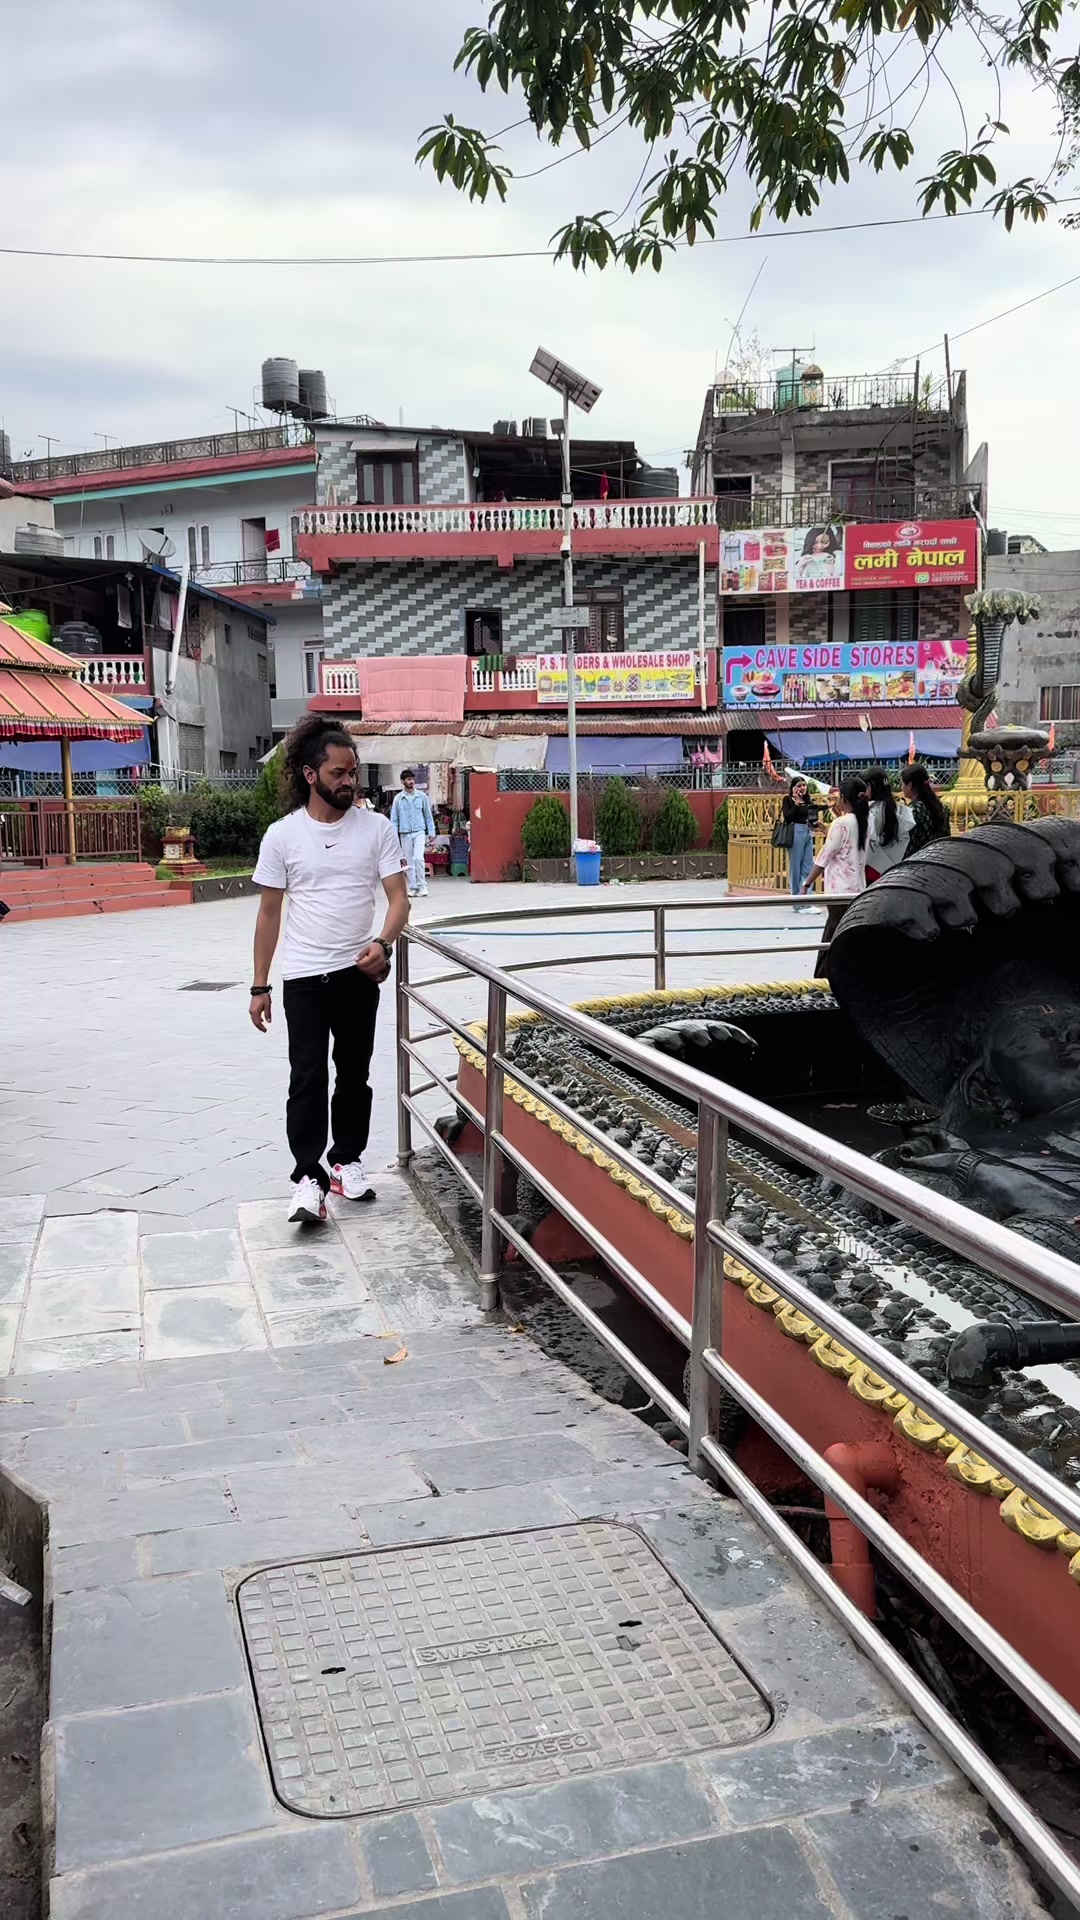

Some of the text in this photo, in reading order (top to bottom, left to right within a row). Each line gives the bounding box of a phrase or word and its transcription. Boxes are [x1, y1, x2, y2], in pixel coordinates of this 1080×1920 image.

[853, 547, 966, 570] लमी नेपाल
[796, 578, 840, 588] TEA & COFFEE
[540, 653, 691, 670] P. S. TDERS & WHOLESALE SHOP
[755, 645, 916, 669] CAVE SIDE STORES
[419, 1634, 549, 1663] SWASTIKA
